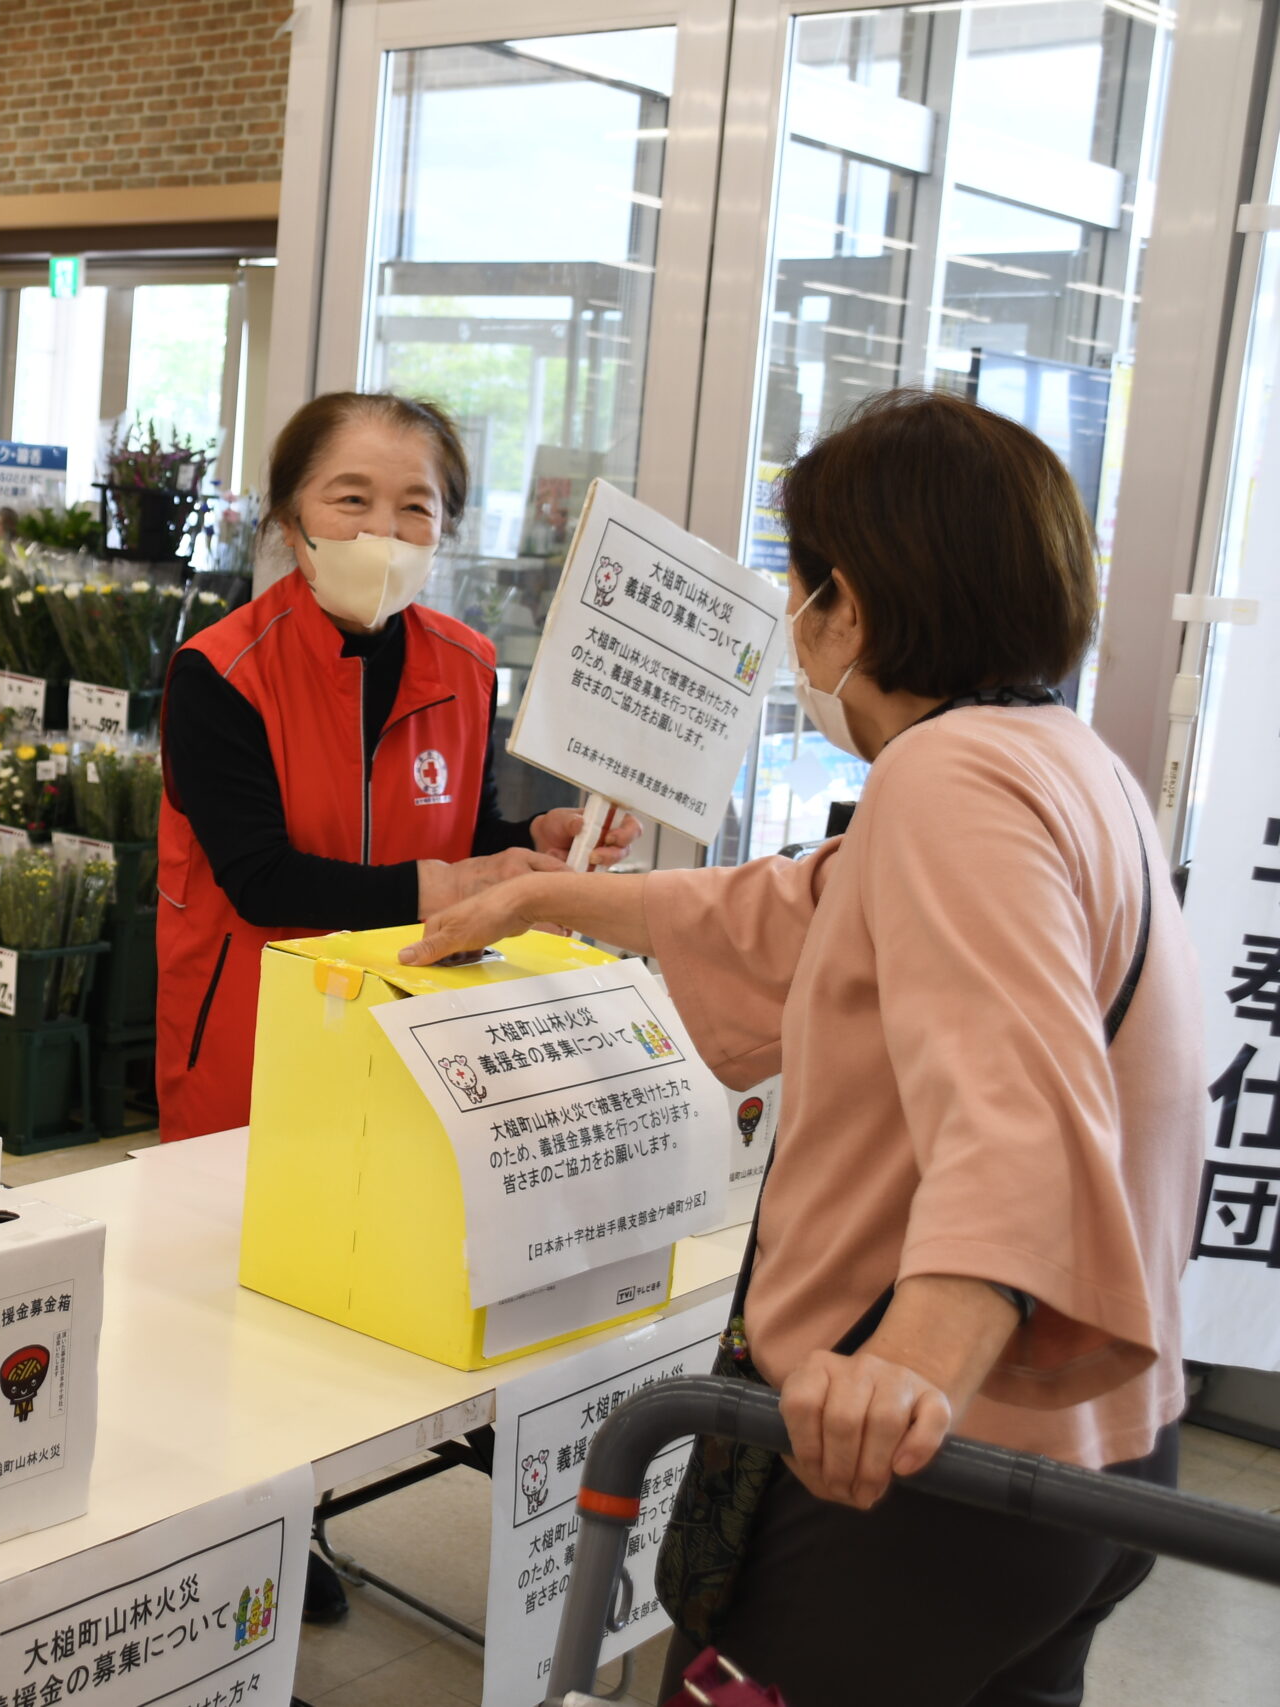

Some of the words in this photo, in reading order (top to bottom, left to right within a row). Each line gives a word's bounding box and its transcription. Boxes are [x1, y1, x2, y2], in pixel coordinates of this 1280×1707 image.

[624, 576, 742, 657] 義援金の募集について
[649, 561, 733, 625] 大槌町山林火災
[571, 644, 730, 740] のため、義援金募集を行っております。
[585, 626, 740, 719] 大槌町山林火災で被害を受けた方々
[570, 670, 706, 751] 皆さまのご協力をお願いします。
[478, 1028, 633, 1076] 義援金の募集について
[485, 1007, 598, 1045] 大槌町山林火災
[489, 1077, 691, 1142] 大槌町山林火災で被害を受けた方々
[489, 1102, 700, 1170] のため、義援金募集を行っております。
[502, 1133, 678, 1195] 皆さまのご協力をお願いします。
[23, 1573, 201, 1675] 大槌町山林火災
